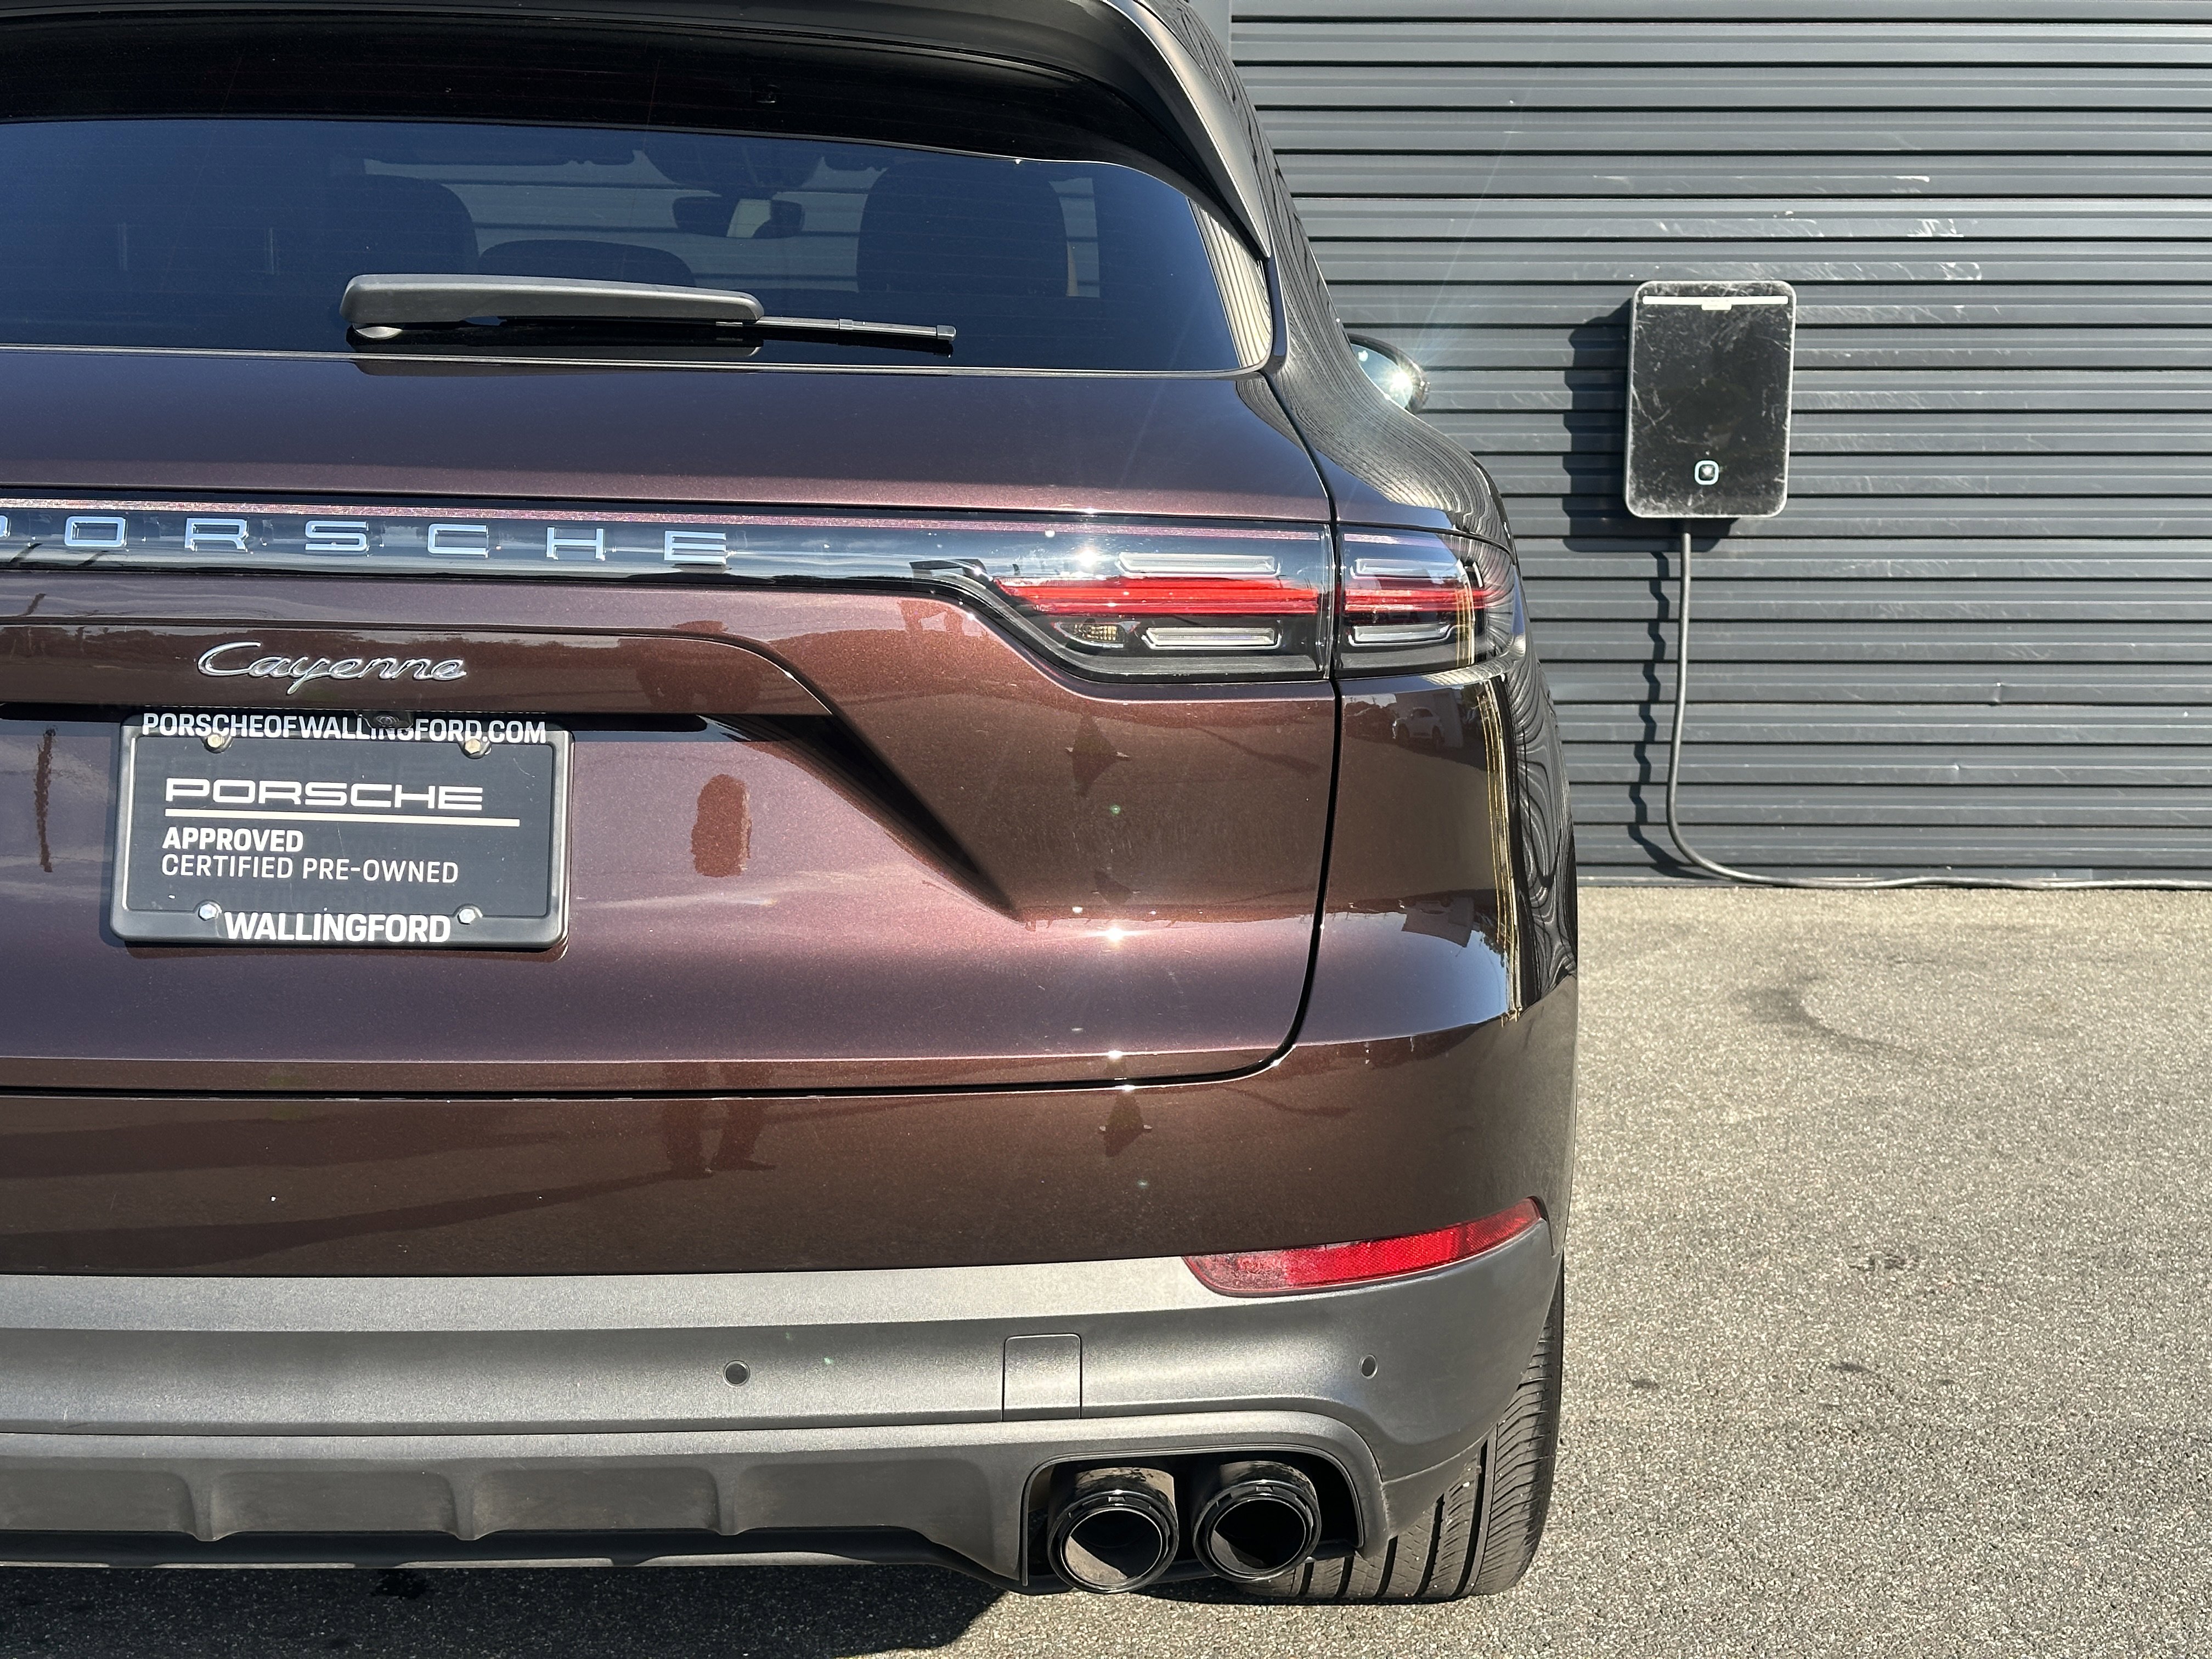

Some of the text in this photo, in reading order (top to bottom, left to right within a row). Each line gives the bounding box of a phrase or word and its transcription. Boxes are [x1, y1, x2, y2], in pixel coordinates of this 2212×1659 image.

[0, 515, 727, 564] ORSCHE
[198, 641, 467, 695] Cayenne
[165, 777, 483, 811] PORSCHE
[162, 827, 304, 853] APPROVED
[161, 855, 459, 884] CERTIFIED PRE-OWNED
[224, 912, 451, 943] WALLINGFORD
